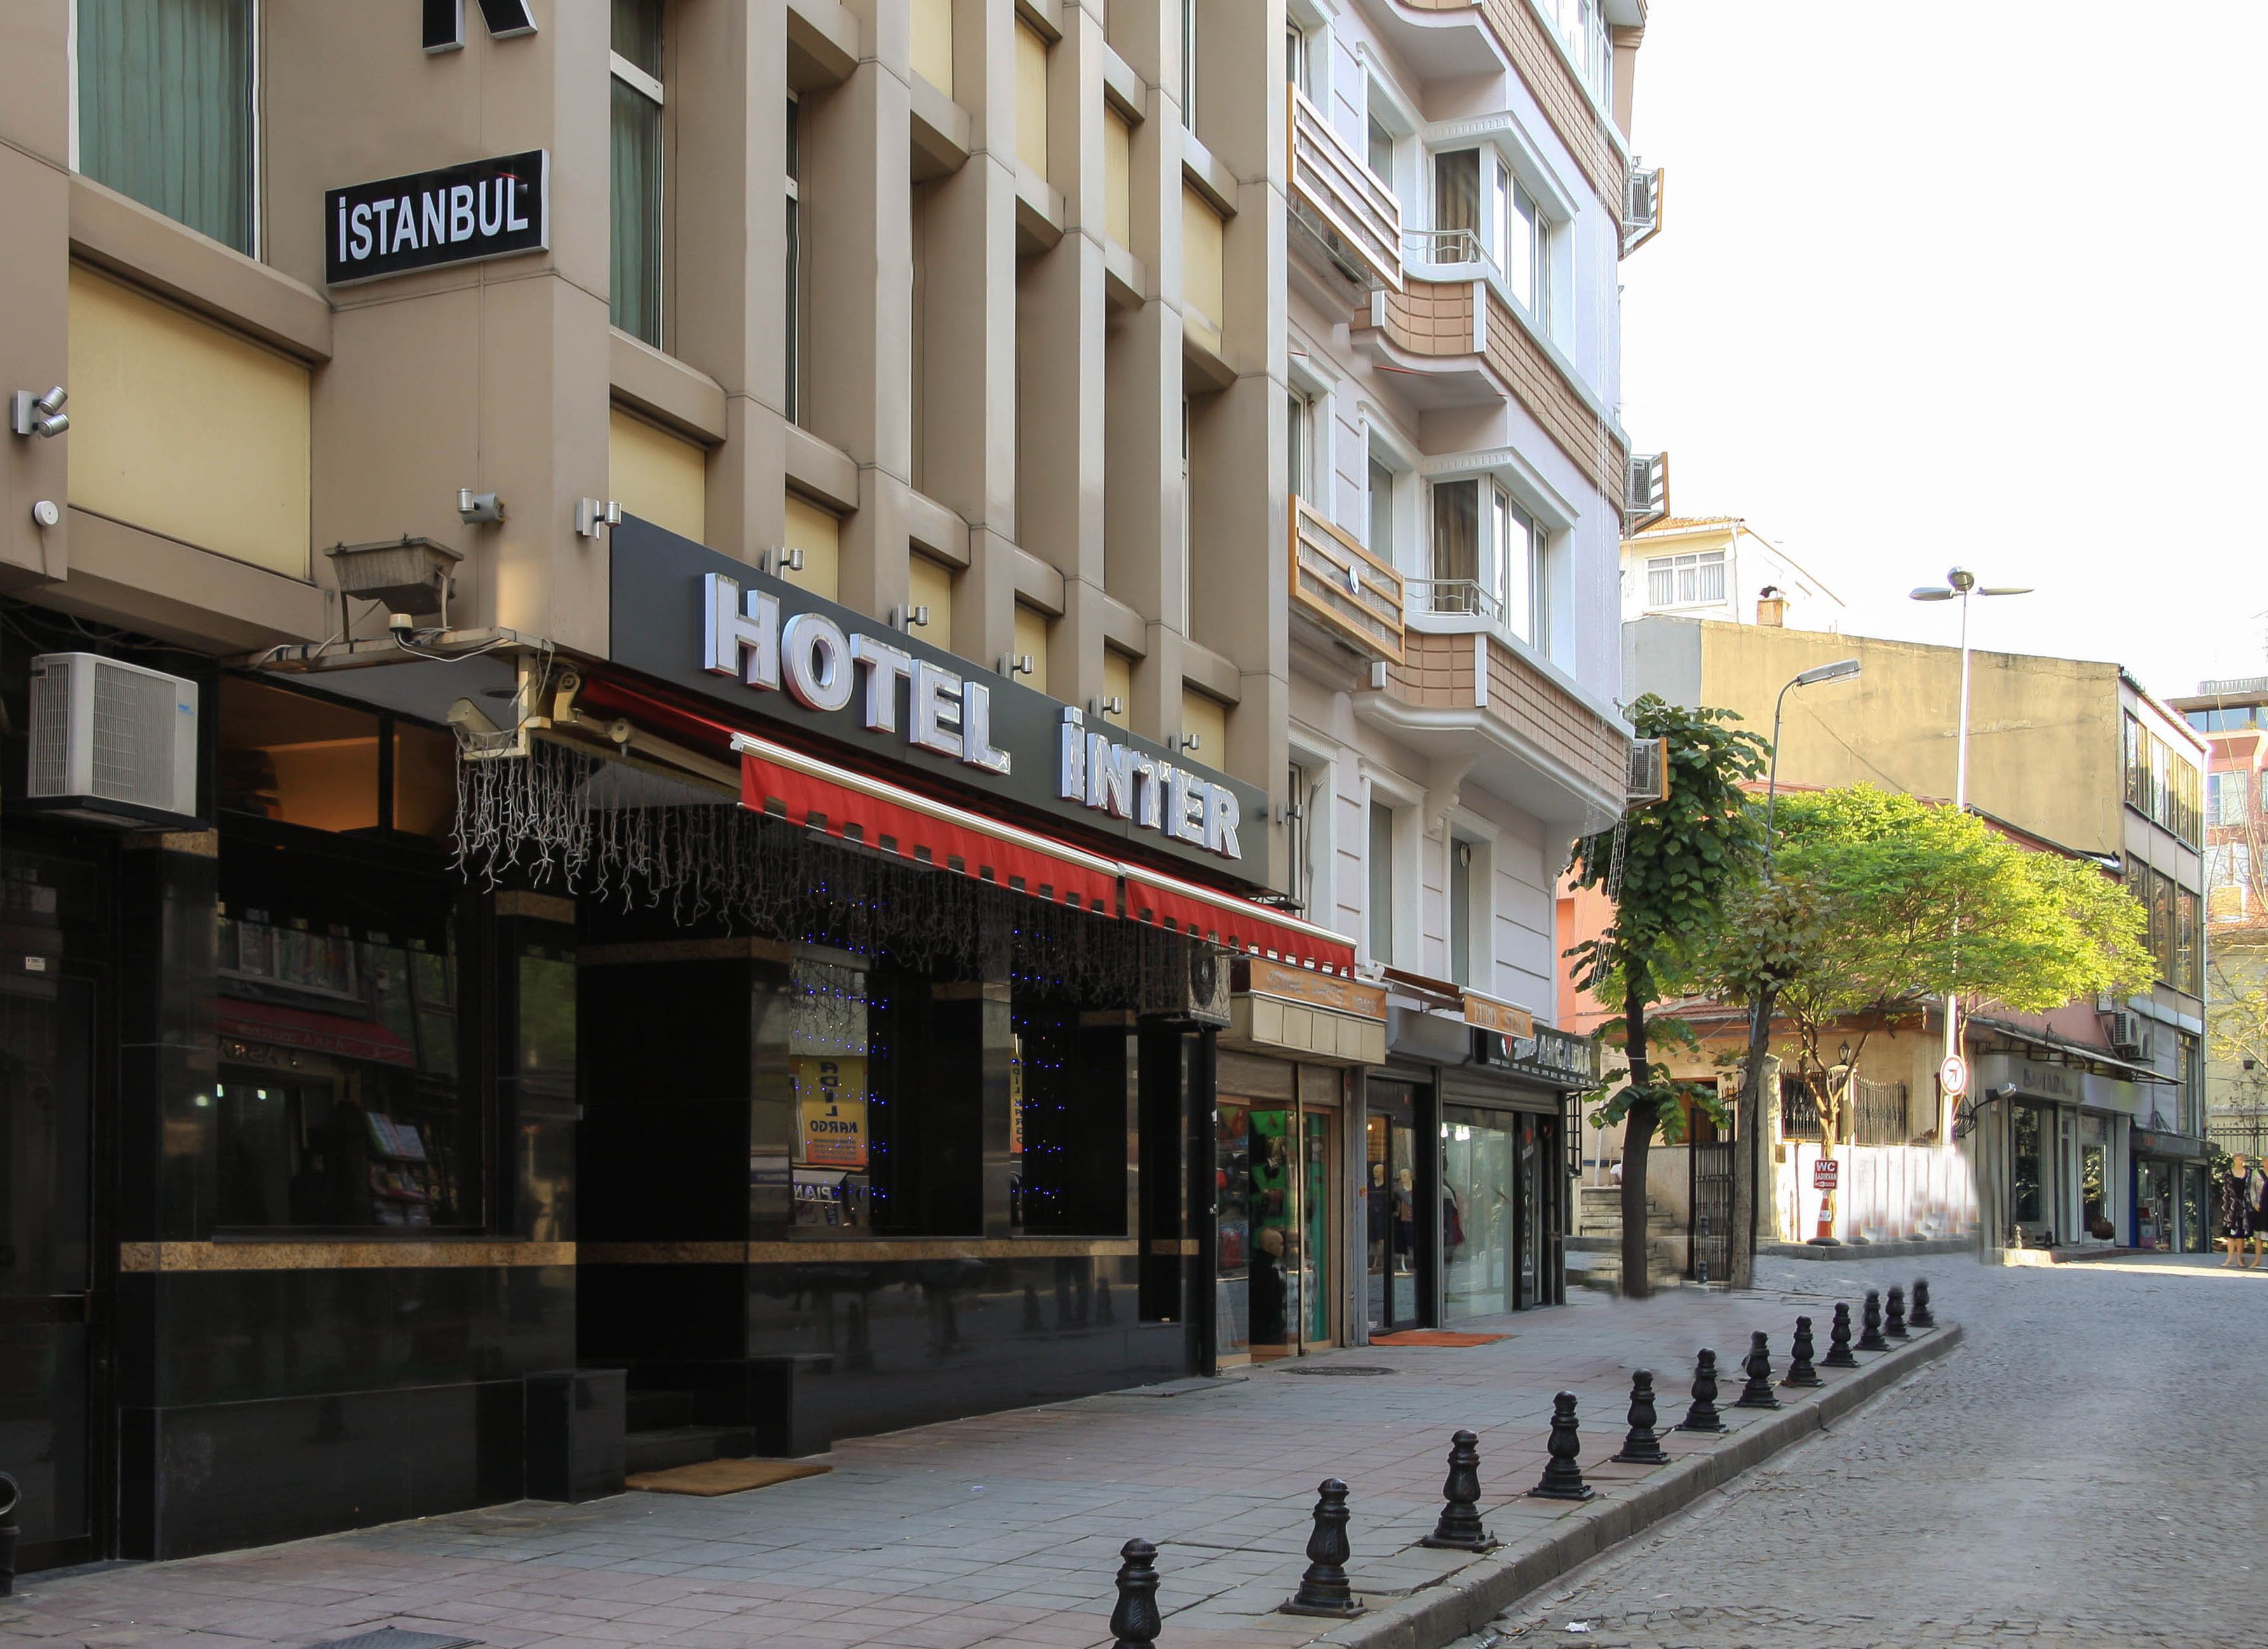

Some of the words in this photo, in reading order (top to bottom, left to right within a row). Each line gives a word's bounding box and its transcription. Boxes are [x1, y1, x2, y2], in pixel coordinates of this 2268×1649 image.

[339, 177, 529, 262] İSTANBUL
[705, 572, 1011, 776] HOTEL
[1062, 706, 1242, 860] İNTER
[1816, 1161, 1835, 1172] WC
